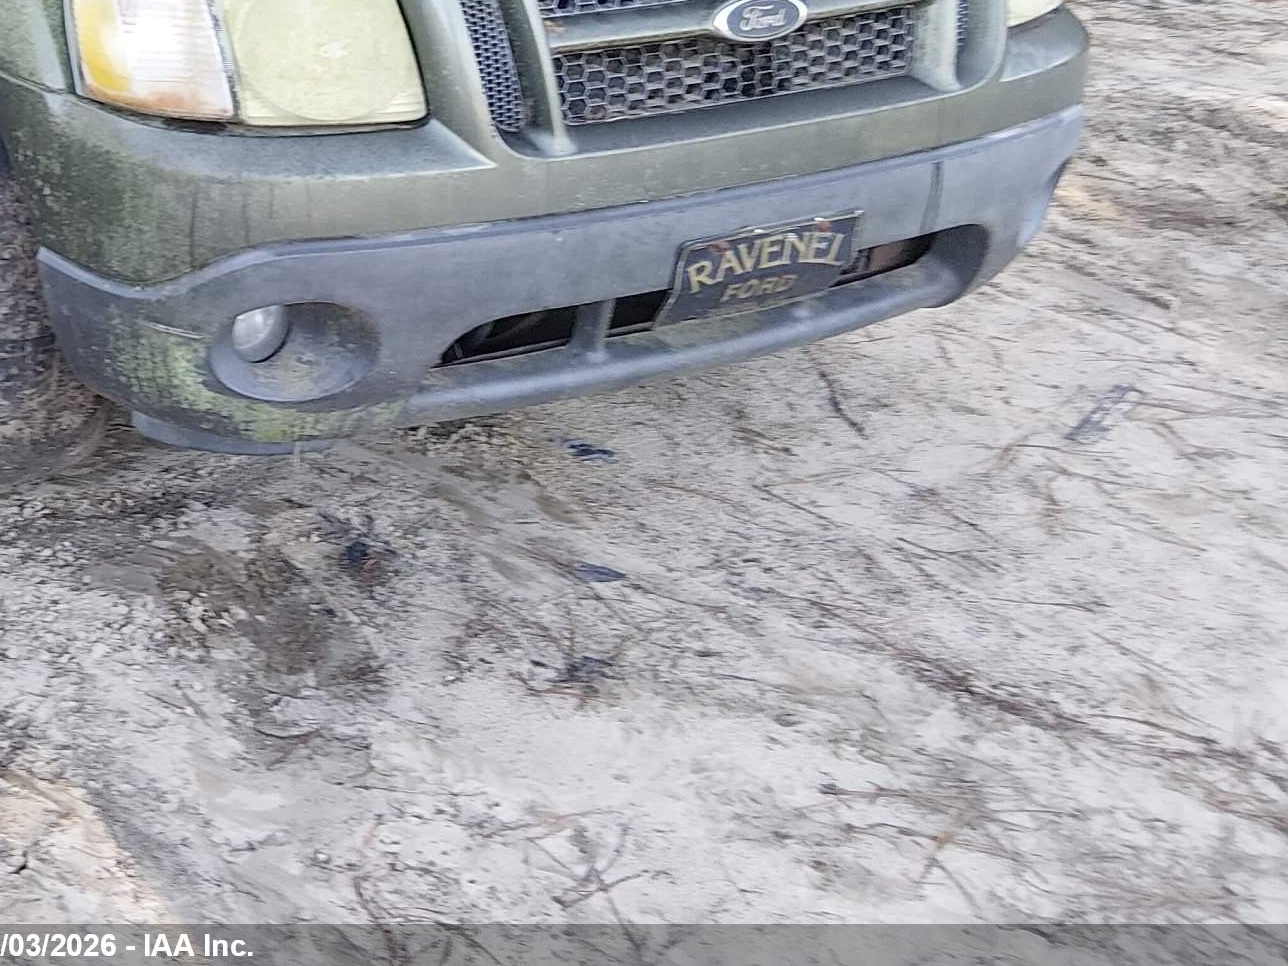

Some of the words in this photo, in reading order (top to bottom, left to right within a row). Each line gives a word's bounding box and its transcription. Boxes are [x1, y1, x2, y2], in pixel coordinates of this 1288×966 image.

[739, 4, 787, 31] Ford
[686, 231, 847, 295] RAVENEL
[720, 274, 799, 303] FORD
